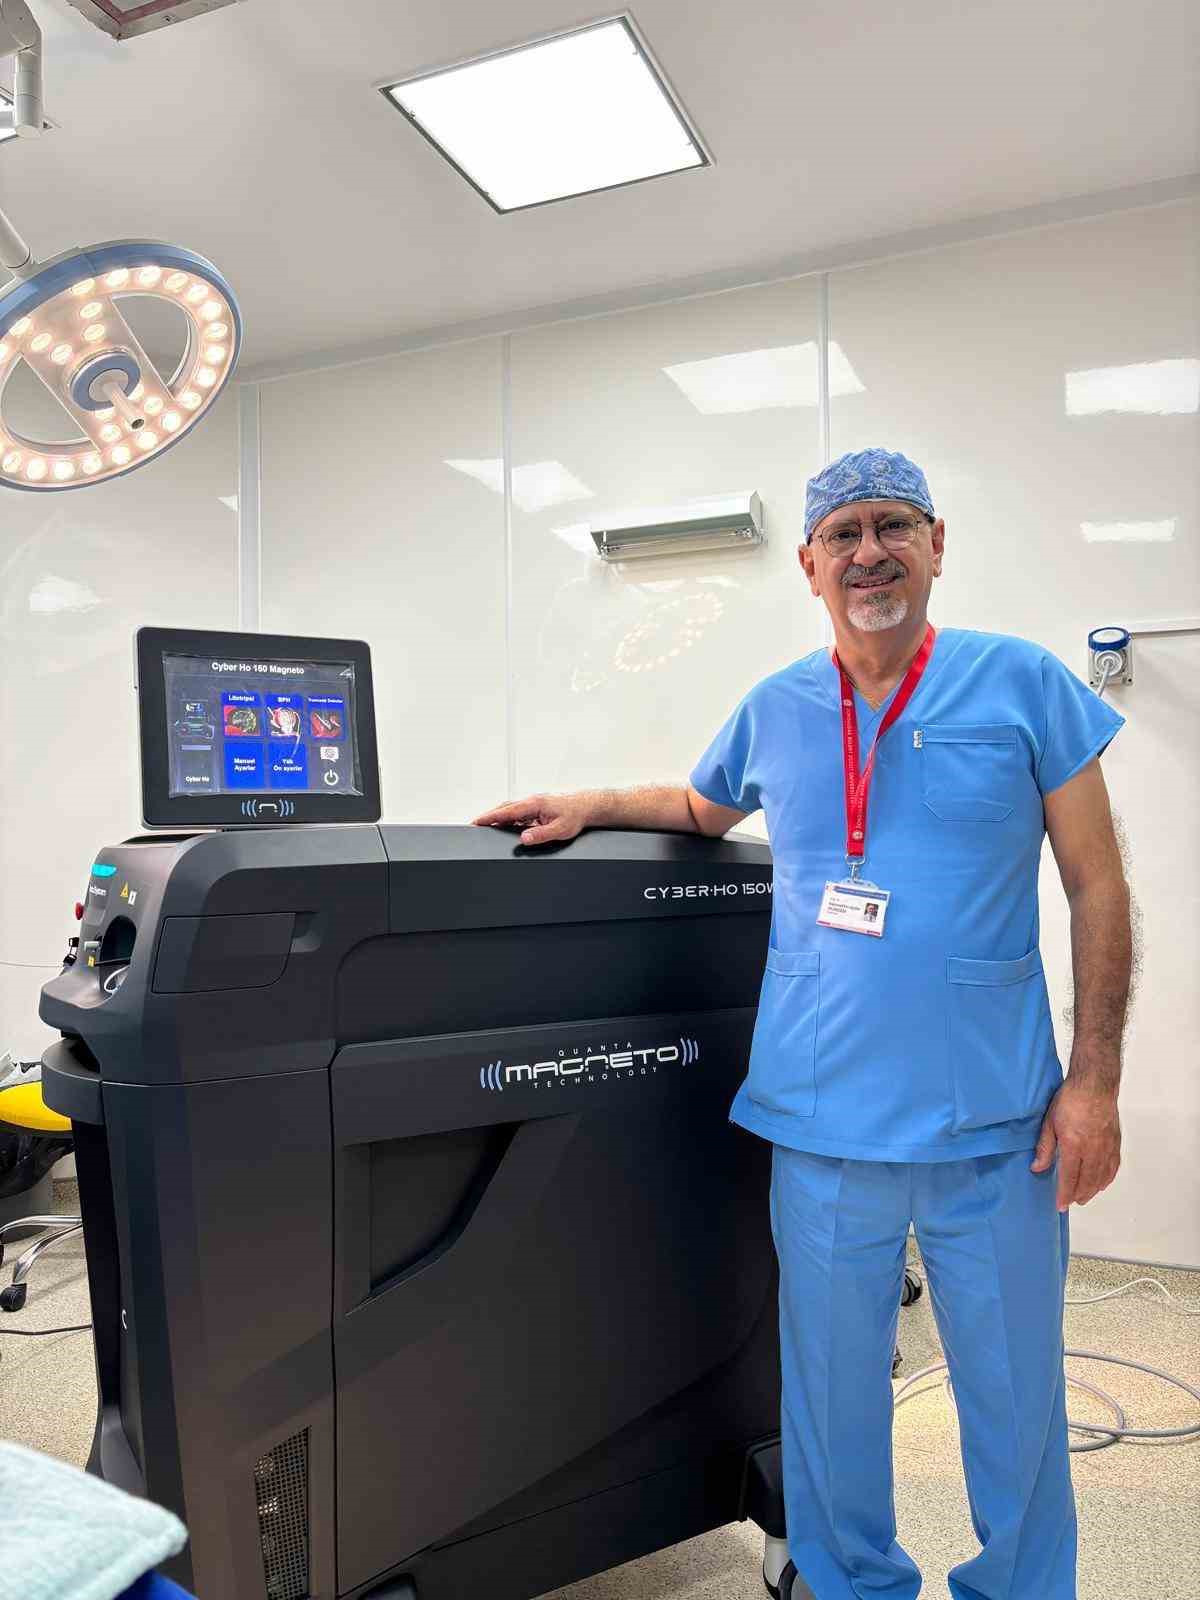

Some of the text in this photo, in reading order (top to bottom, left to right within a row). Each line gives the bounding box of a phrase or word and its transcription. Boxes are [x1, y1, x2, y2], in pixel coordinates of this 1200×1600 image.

[211, 662, 305, 675] Cyber Ho 150 Magneto
[558, 1042, 632, 1057] QUANTA
[533, 1066, 657, 1089] TECHNOLOGY
